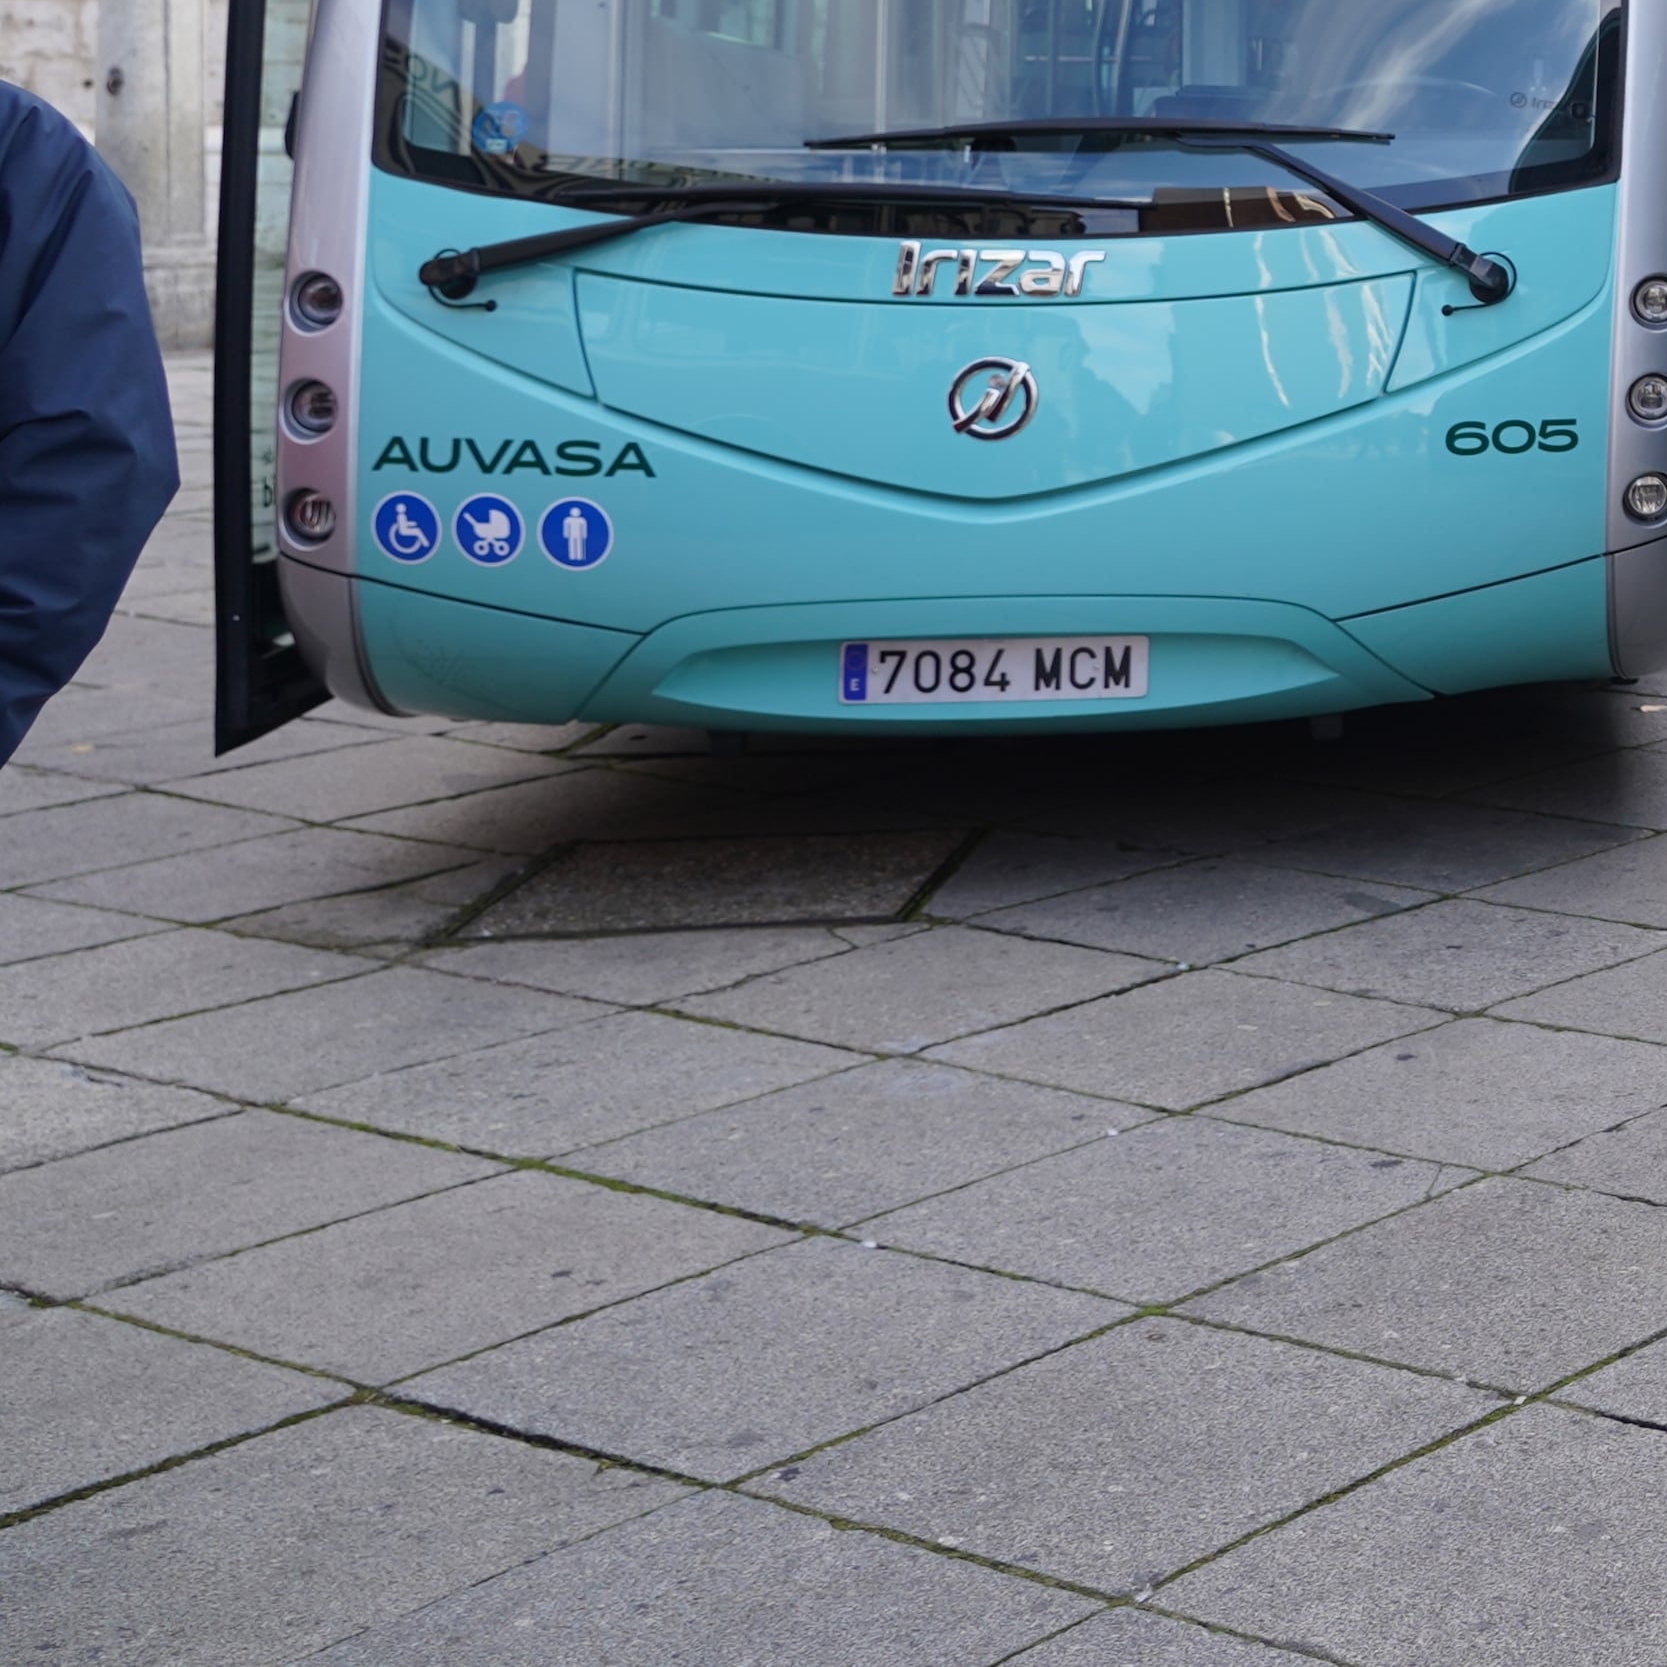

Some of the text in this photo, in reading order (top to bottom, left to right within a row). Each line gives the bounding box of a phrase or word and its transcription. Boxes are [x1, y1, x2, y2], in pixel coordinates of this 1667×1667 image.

[892, 240, 1108, 298] Irizar
[371, 436, 657, 478] AUVASA
[1445, 418, 1580, 456] 605
[850, 645, 1132, 695] E 7084 MCM
